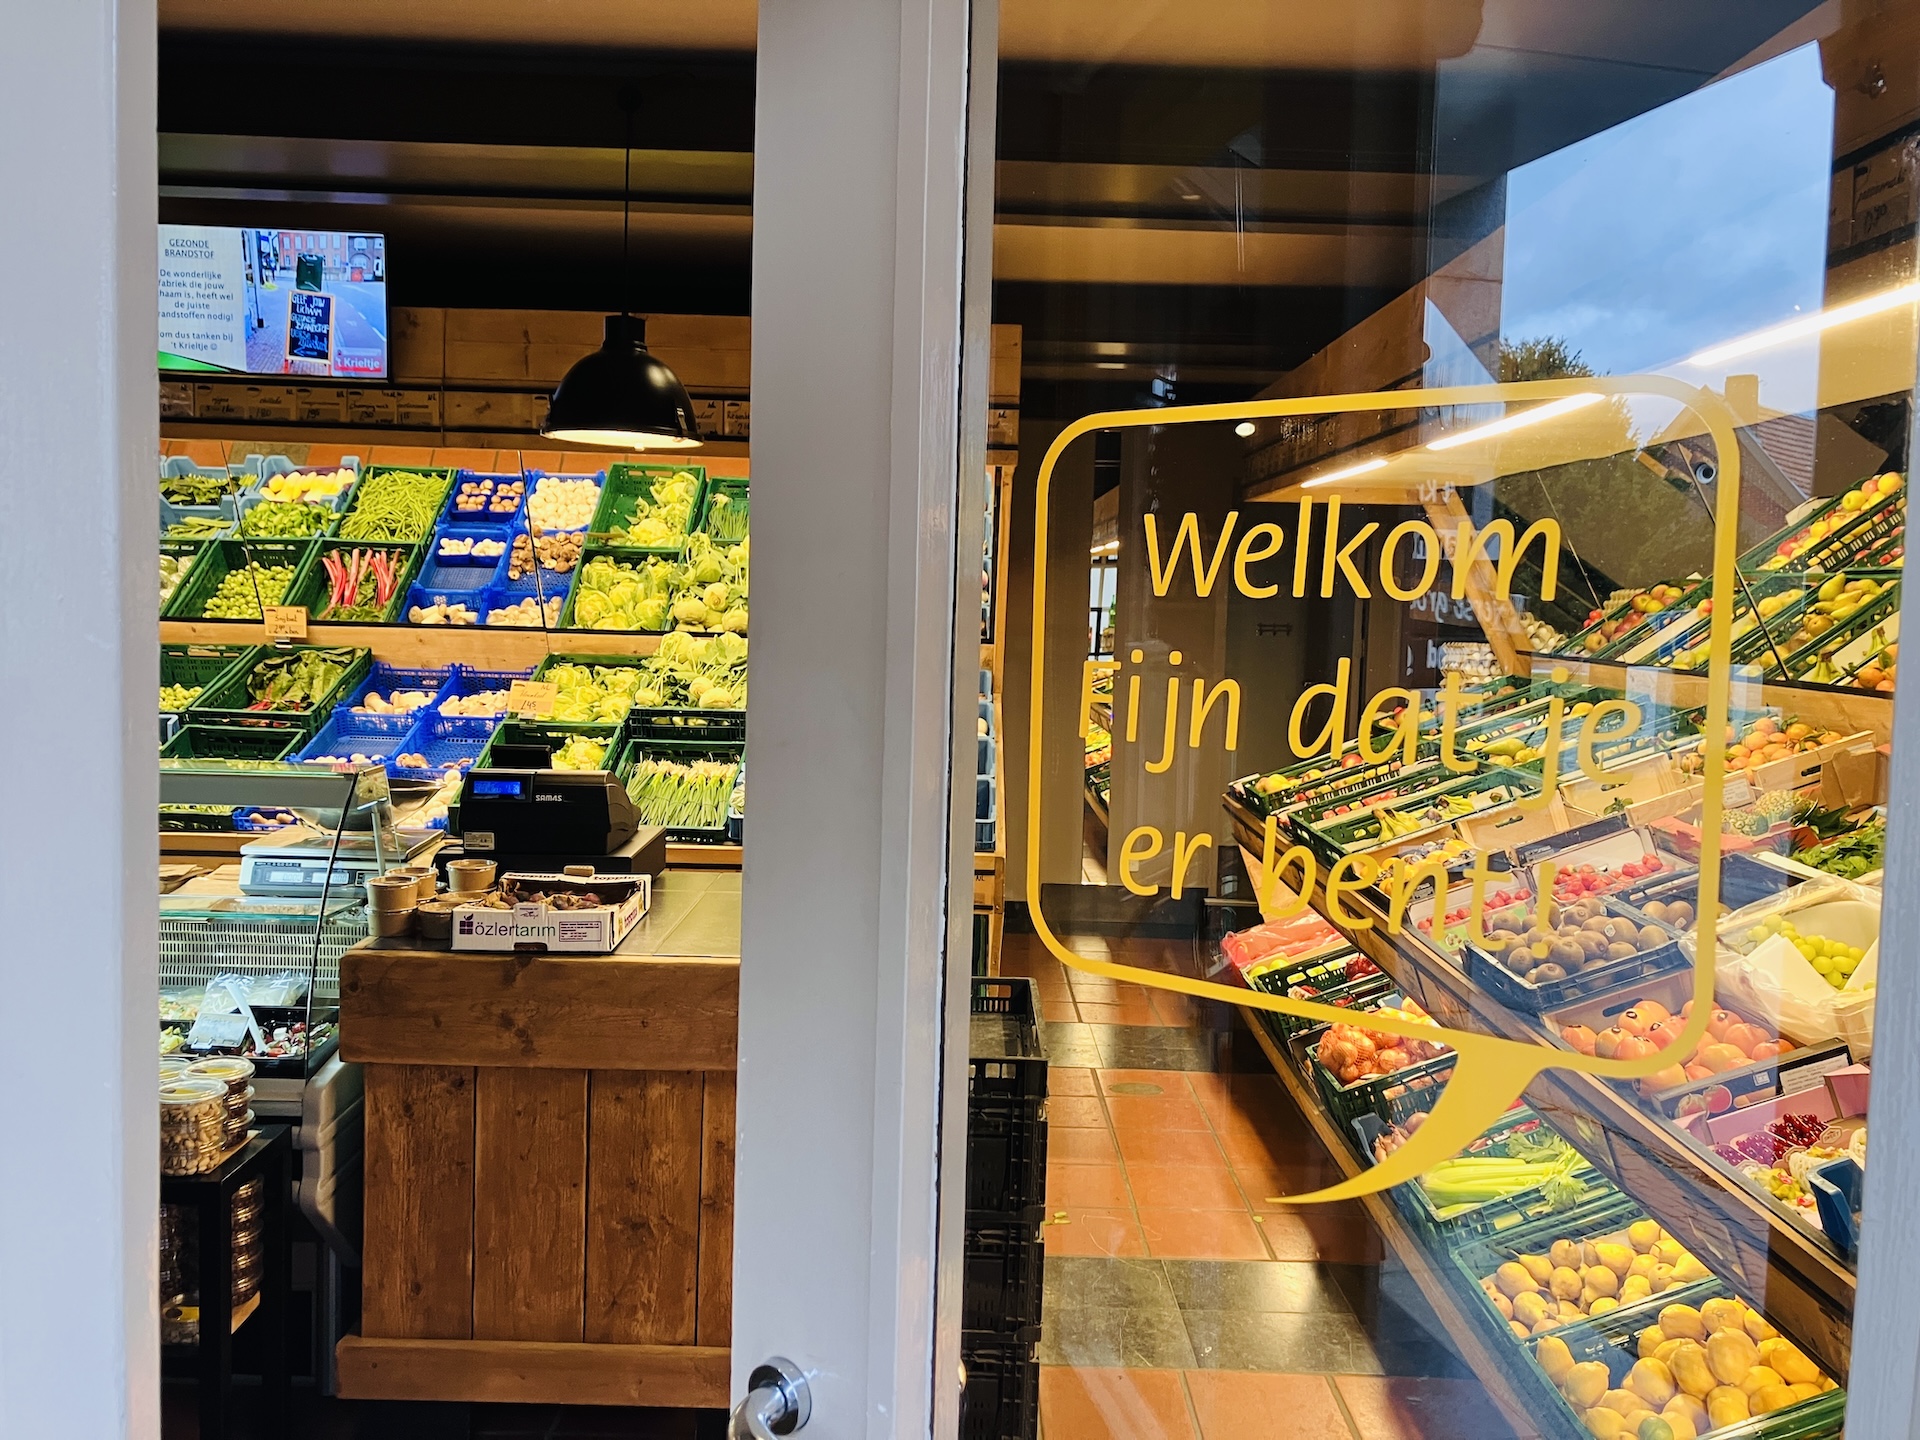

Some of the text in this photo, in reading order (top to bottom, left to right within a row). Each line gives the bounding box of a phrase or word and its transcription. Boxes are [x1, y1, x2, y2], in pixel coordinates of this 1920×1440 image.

[169, 238, 210, 248] GEZONDE
[164, 248, 214, 258] BRANDSTOF
[160, 269, 222, 280] De wonderlijke
[189, 281, 202, 289] die
[204, 282, 224, 290] jouw
[196, 291, 217, 300] heeft
[187, 302, 210, 310] juiste
[158, 311, 205, 319] randstoffen
[175, 331, 190, 339] dus
[192, 332, 220, 340] tanken
[223, 333, 233, 342] bij
[179, 342, 208, 351] Krieltje
[344, 357, 380, 370] Krieltje
[1143, 494, 1561, 601] Welkom
[1078, 649, 1643, 810] Fijn dat je
[1118, 825, 1213, 900] er
